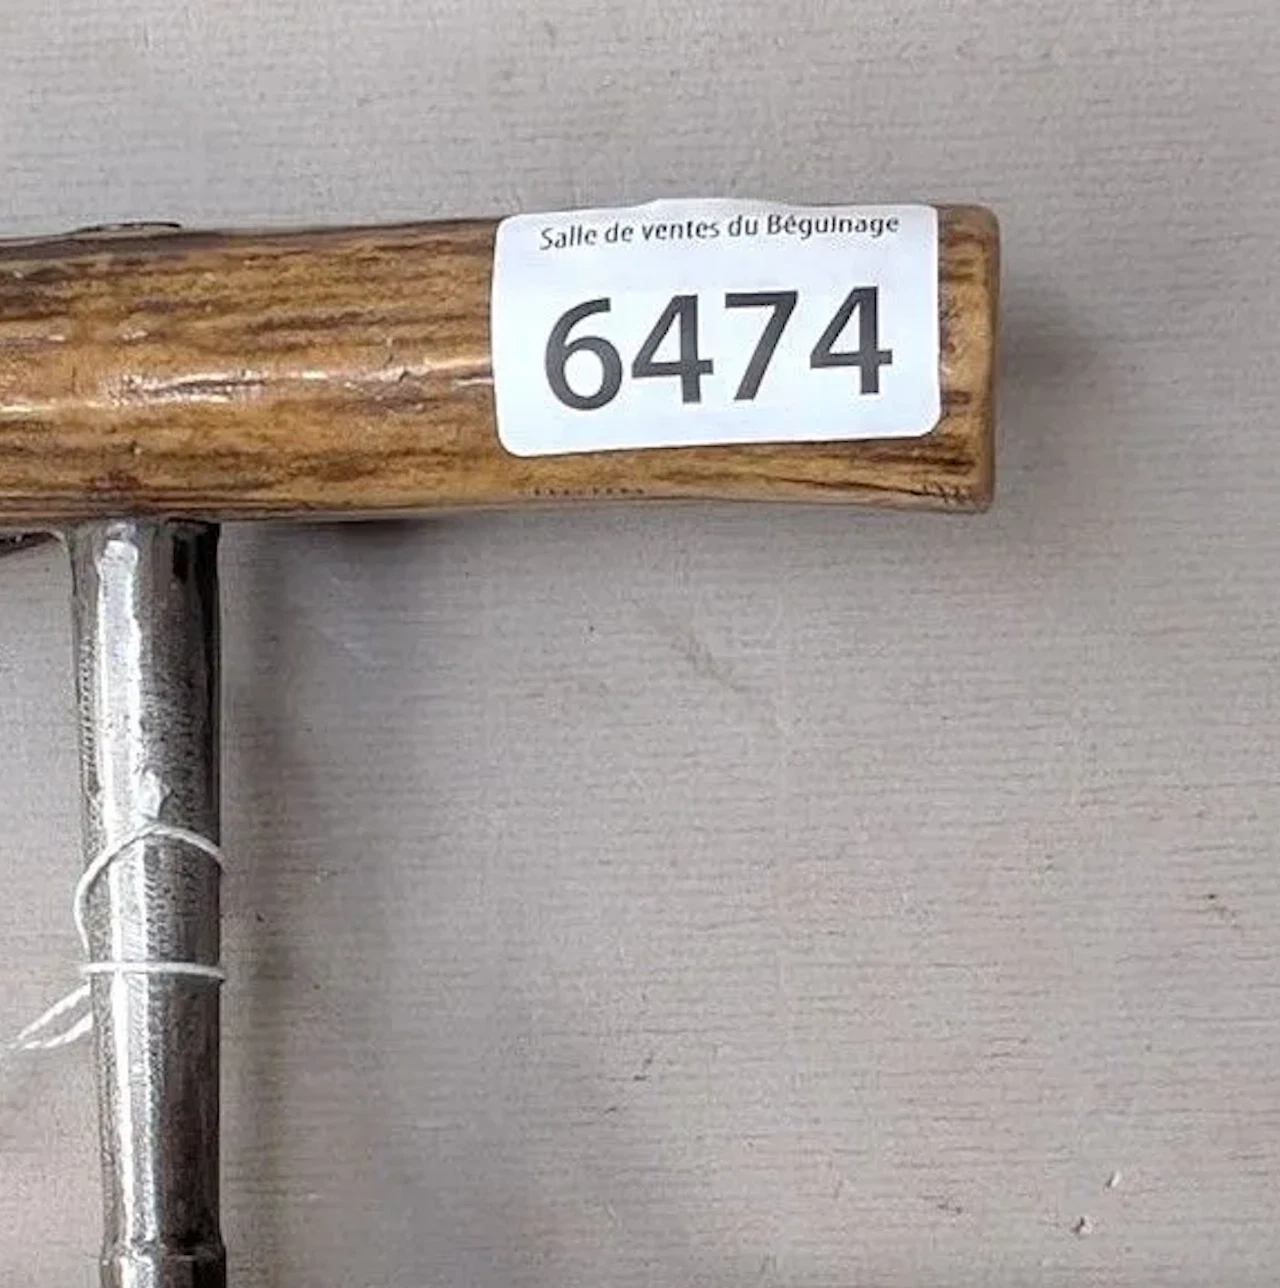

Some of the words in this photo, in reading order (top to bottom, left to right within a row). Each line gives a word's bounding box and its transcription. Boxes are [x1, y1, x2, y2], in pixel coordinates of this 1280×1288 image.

[540, 225, 598, 250] Salle
[605, 222, 635, 243] de
[641, 214, 721, 240] ventes
[728, 214, 758, 237] du
[767, 211, 900, 237] Béguinage
[545, 286, 893, 410] 6474
